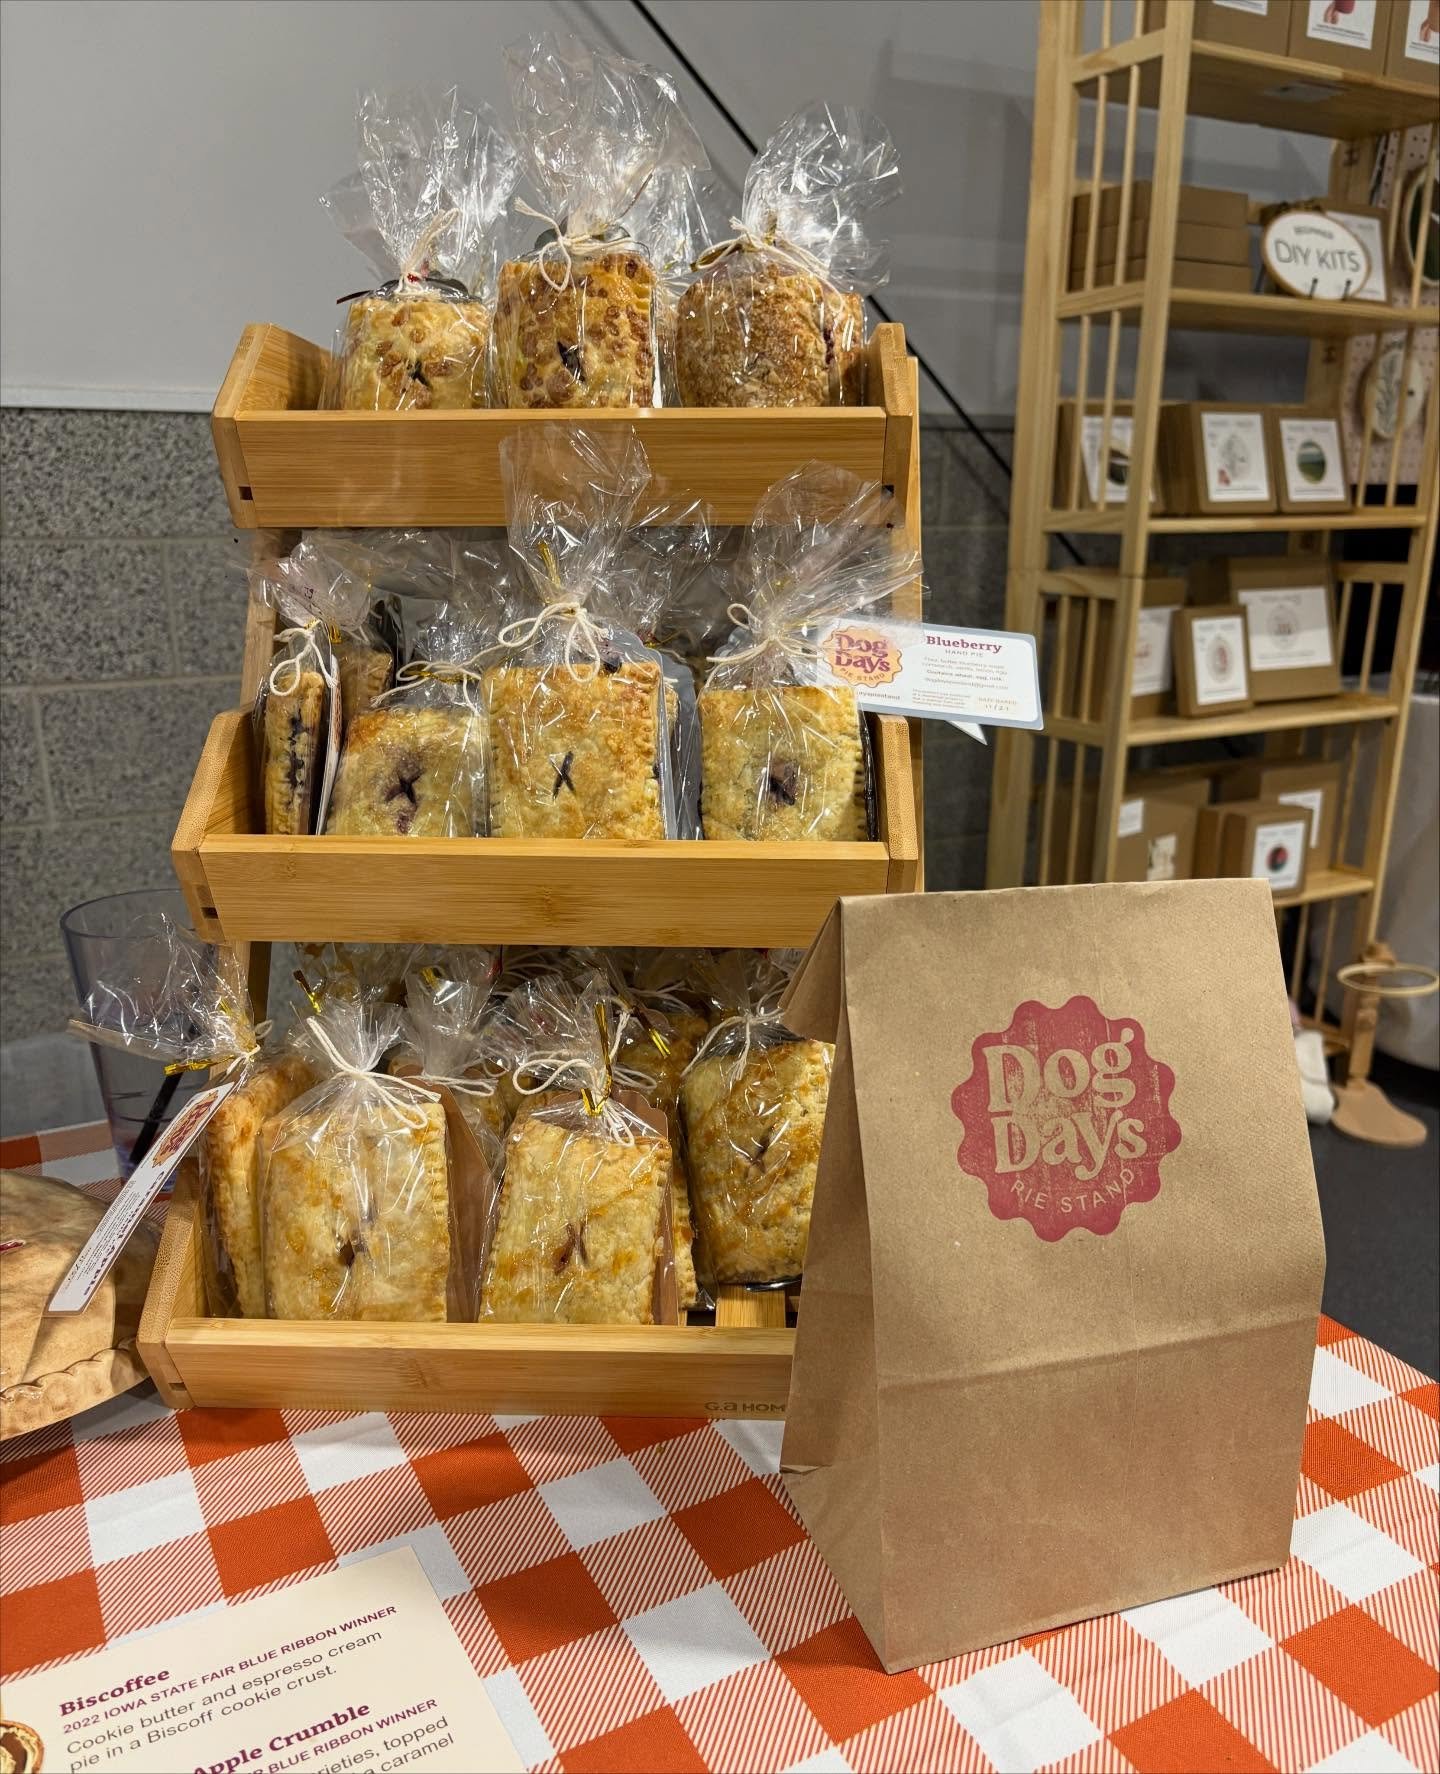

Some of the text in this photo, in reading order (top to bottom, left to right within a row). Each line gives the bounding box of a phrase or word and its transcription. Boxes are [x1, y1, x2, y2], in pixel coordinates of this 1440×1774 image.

[1274, 239, 1361, 272] DIY KITS
[835, 634, 889, 658] Dog
[835, 650, 890, 674] Days
[926, 635, 1002, 654] Blueberry
[982, 1028, 1136, 1113] Dog
[991, 1110, 1148, 1180] Days
[1060, 1168, 1135, 1213] STAND
[58, 1670, 170, 1717] Biscoffee
[63, 1605, 397, 1735] 2022 IOWA STATE FAIR BLUE RIBBON WINNER
[67, 1631, 383, 1754] Cookie butter and espresso cream
[70, 1664, 337, 1774] pie in a Biscoff cookie crust.
[268, 1703, 371, 1752] Crumble
[268, 1698, 438, 1774] BLUE RIBBON WINNER
[316, 1715, 449, 1774] rieties, topped
[380, 1732, 455, 1773] caramel
